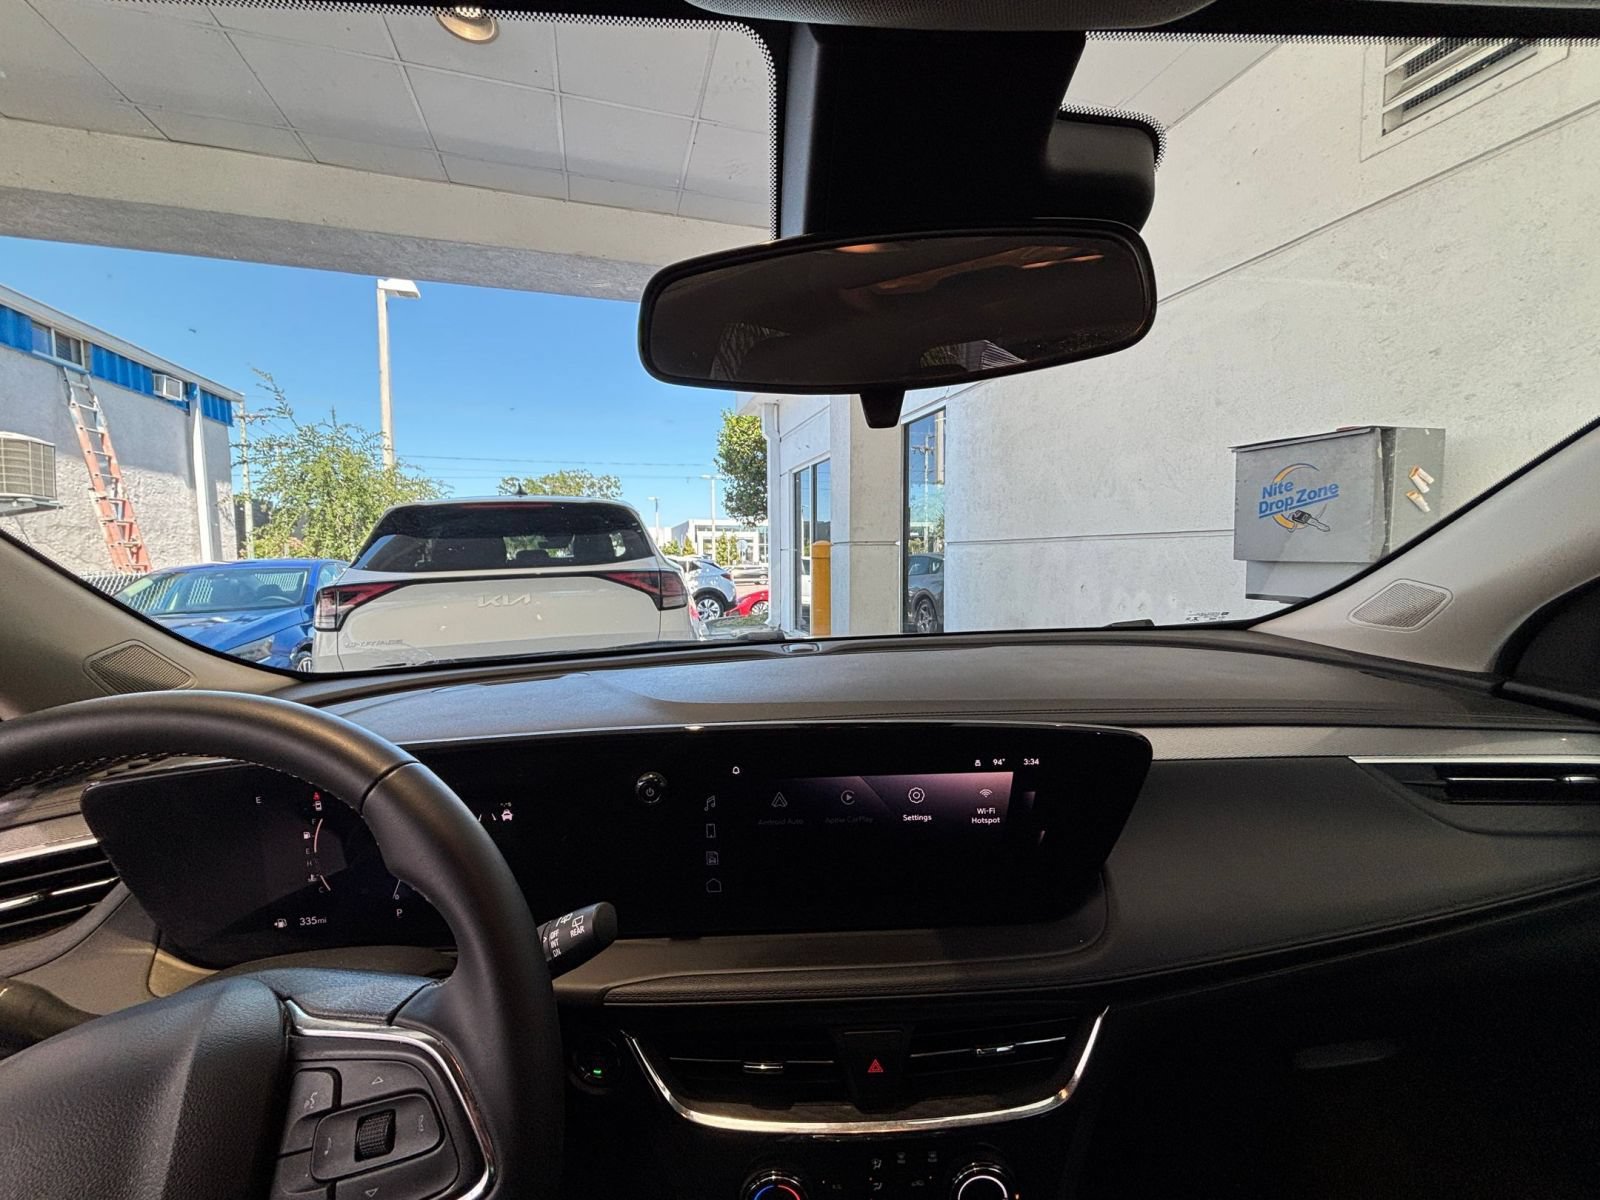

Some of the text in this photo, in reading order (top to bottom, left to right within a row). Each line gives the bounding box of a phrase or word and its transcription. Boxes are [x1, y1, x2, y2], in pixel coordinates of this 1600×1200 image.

[1262, 481, 1294, 499] Nite
[1258, 483, 1339, 514] Drop Zone
[478, 593, 531, 608] KIA
[1023, 758, 1040, 766] 3:34
[976, 807, 996, 815] Wi-Fi
[902, 814, 932, 823] Settings
[971, 816, 1001, 826] Hotspot
[396, 908, 403, 917] P
[550, 929, 560, 940] OFF
[570, 925, 585, 938] REAR
[550, 938, 559, 949] INT
[552, 948, 562, 957] ON
